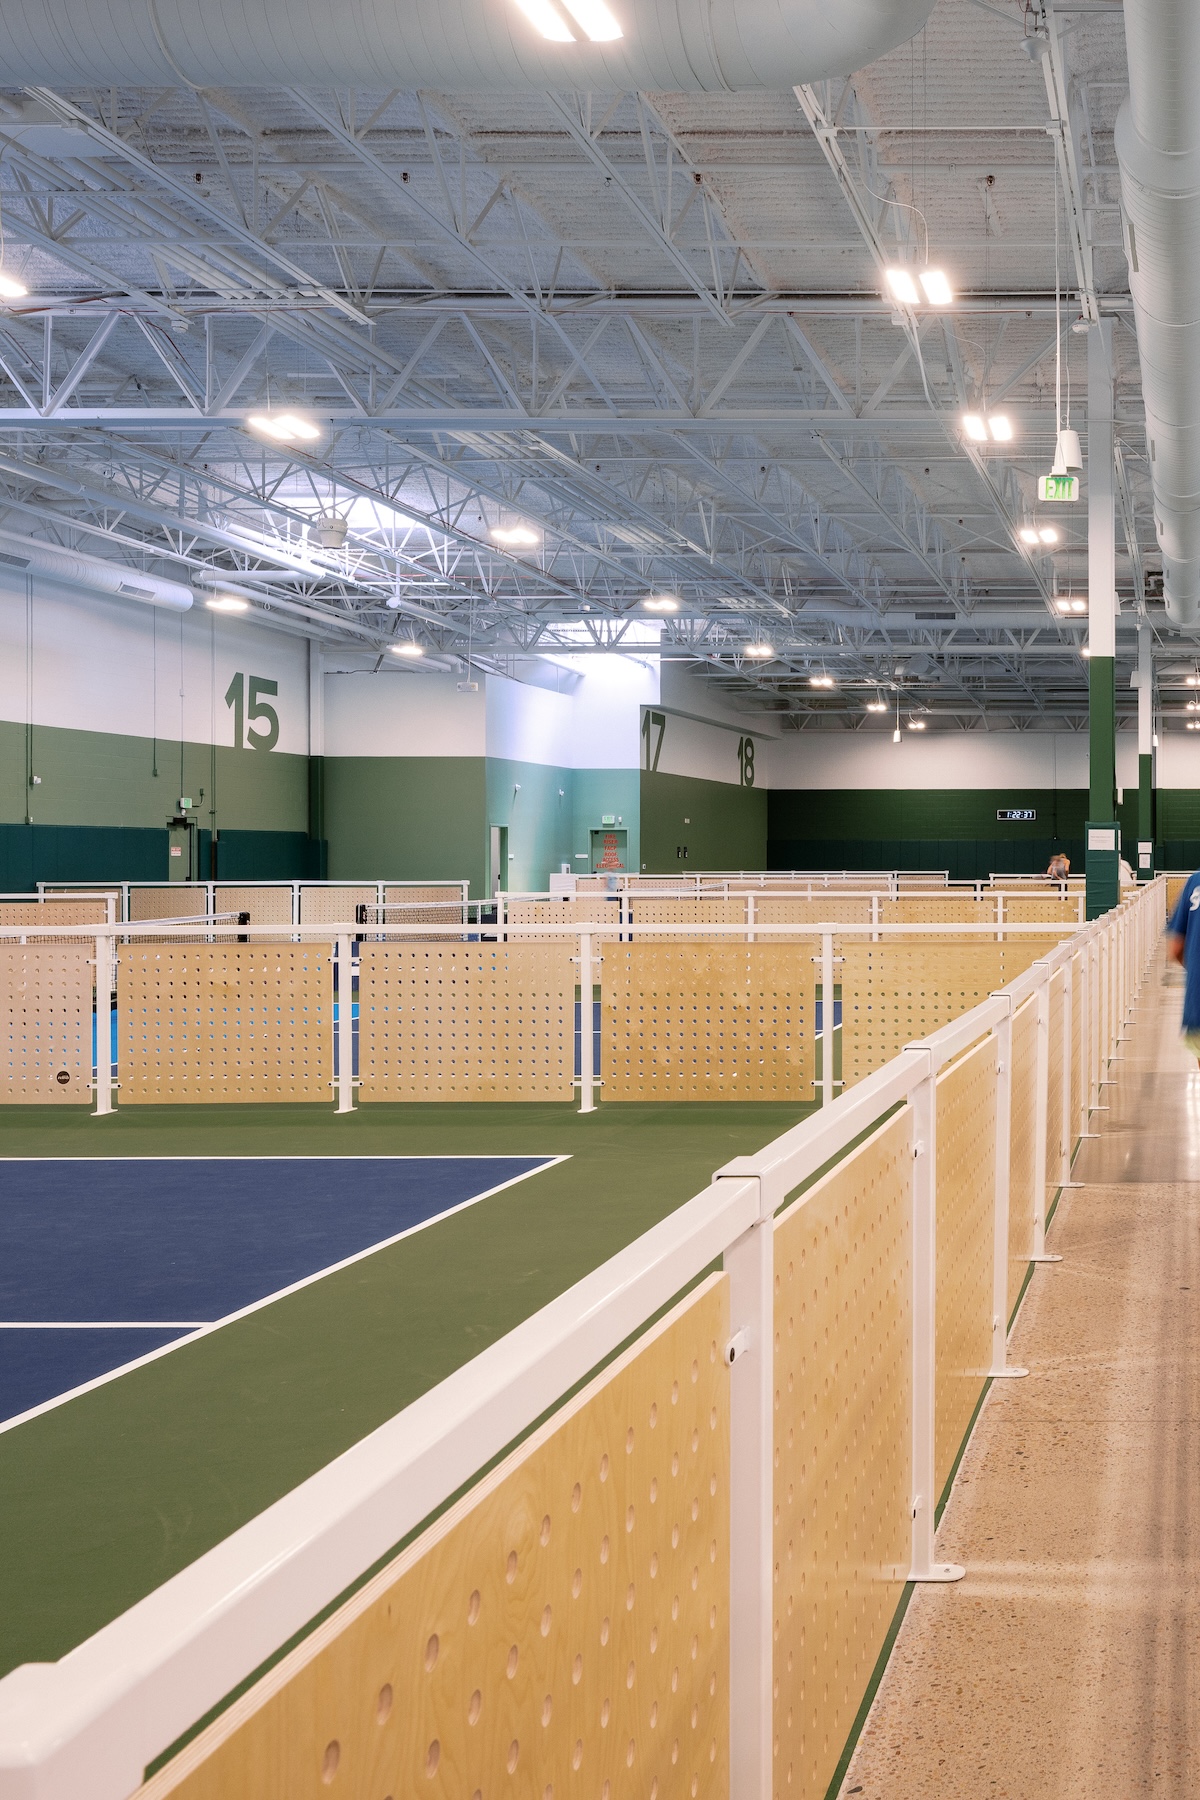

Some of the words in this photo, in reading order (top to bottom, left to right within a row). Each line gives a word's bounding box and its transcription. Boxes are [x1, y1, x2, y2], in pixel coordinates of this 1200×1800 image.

[1045, 477, 1074, 499] EXIT
[224, 672, 280, 751] 15
[641, 709, 666, 772] 17
[737, 736, 755, 787] 18
